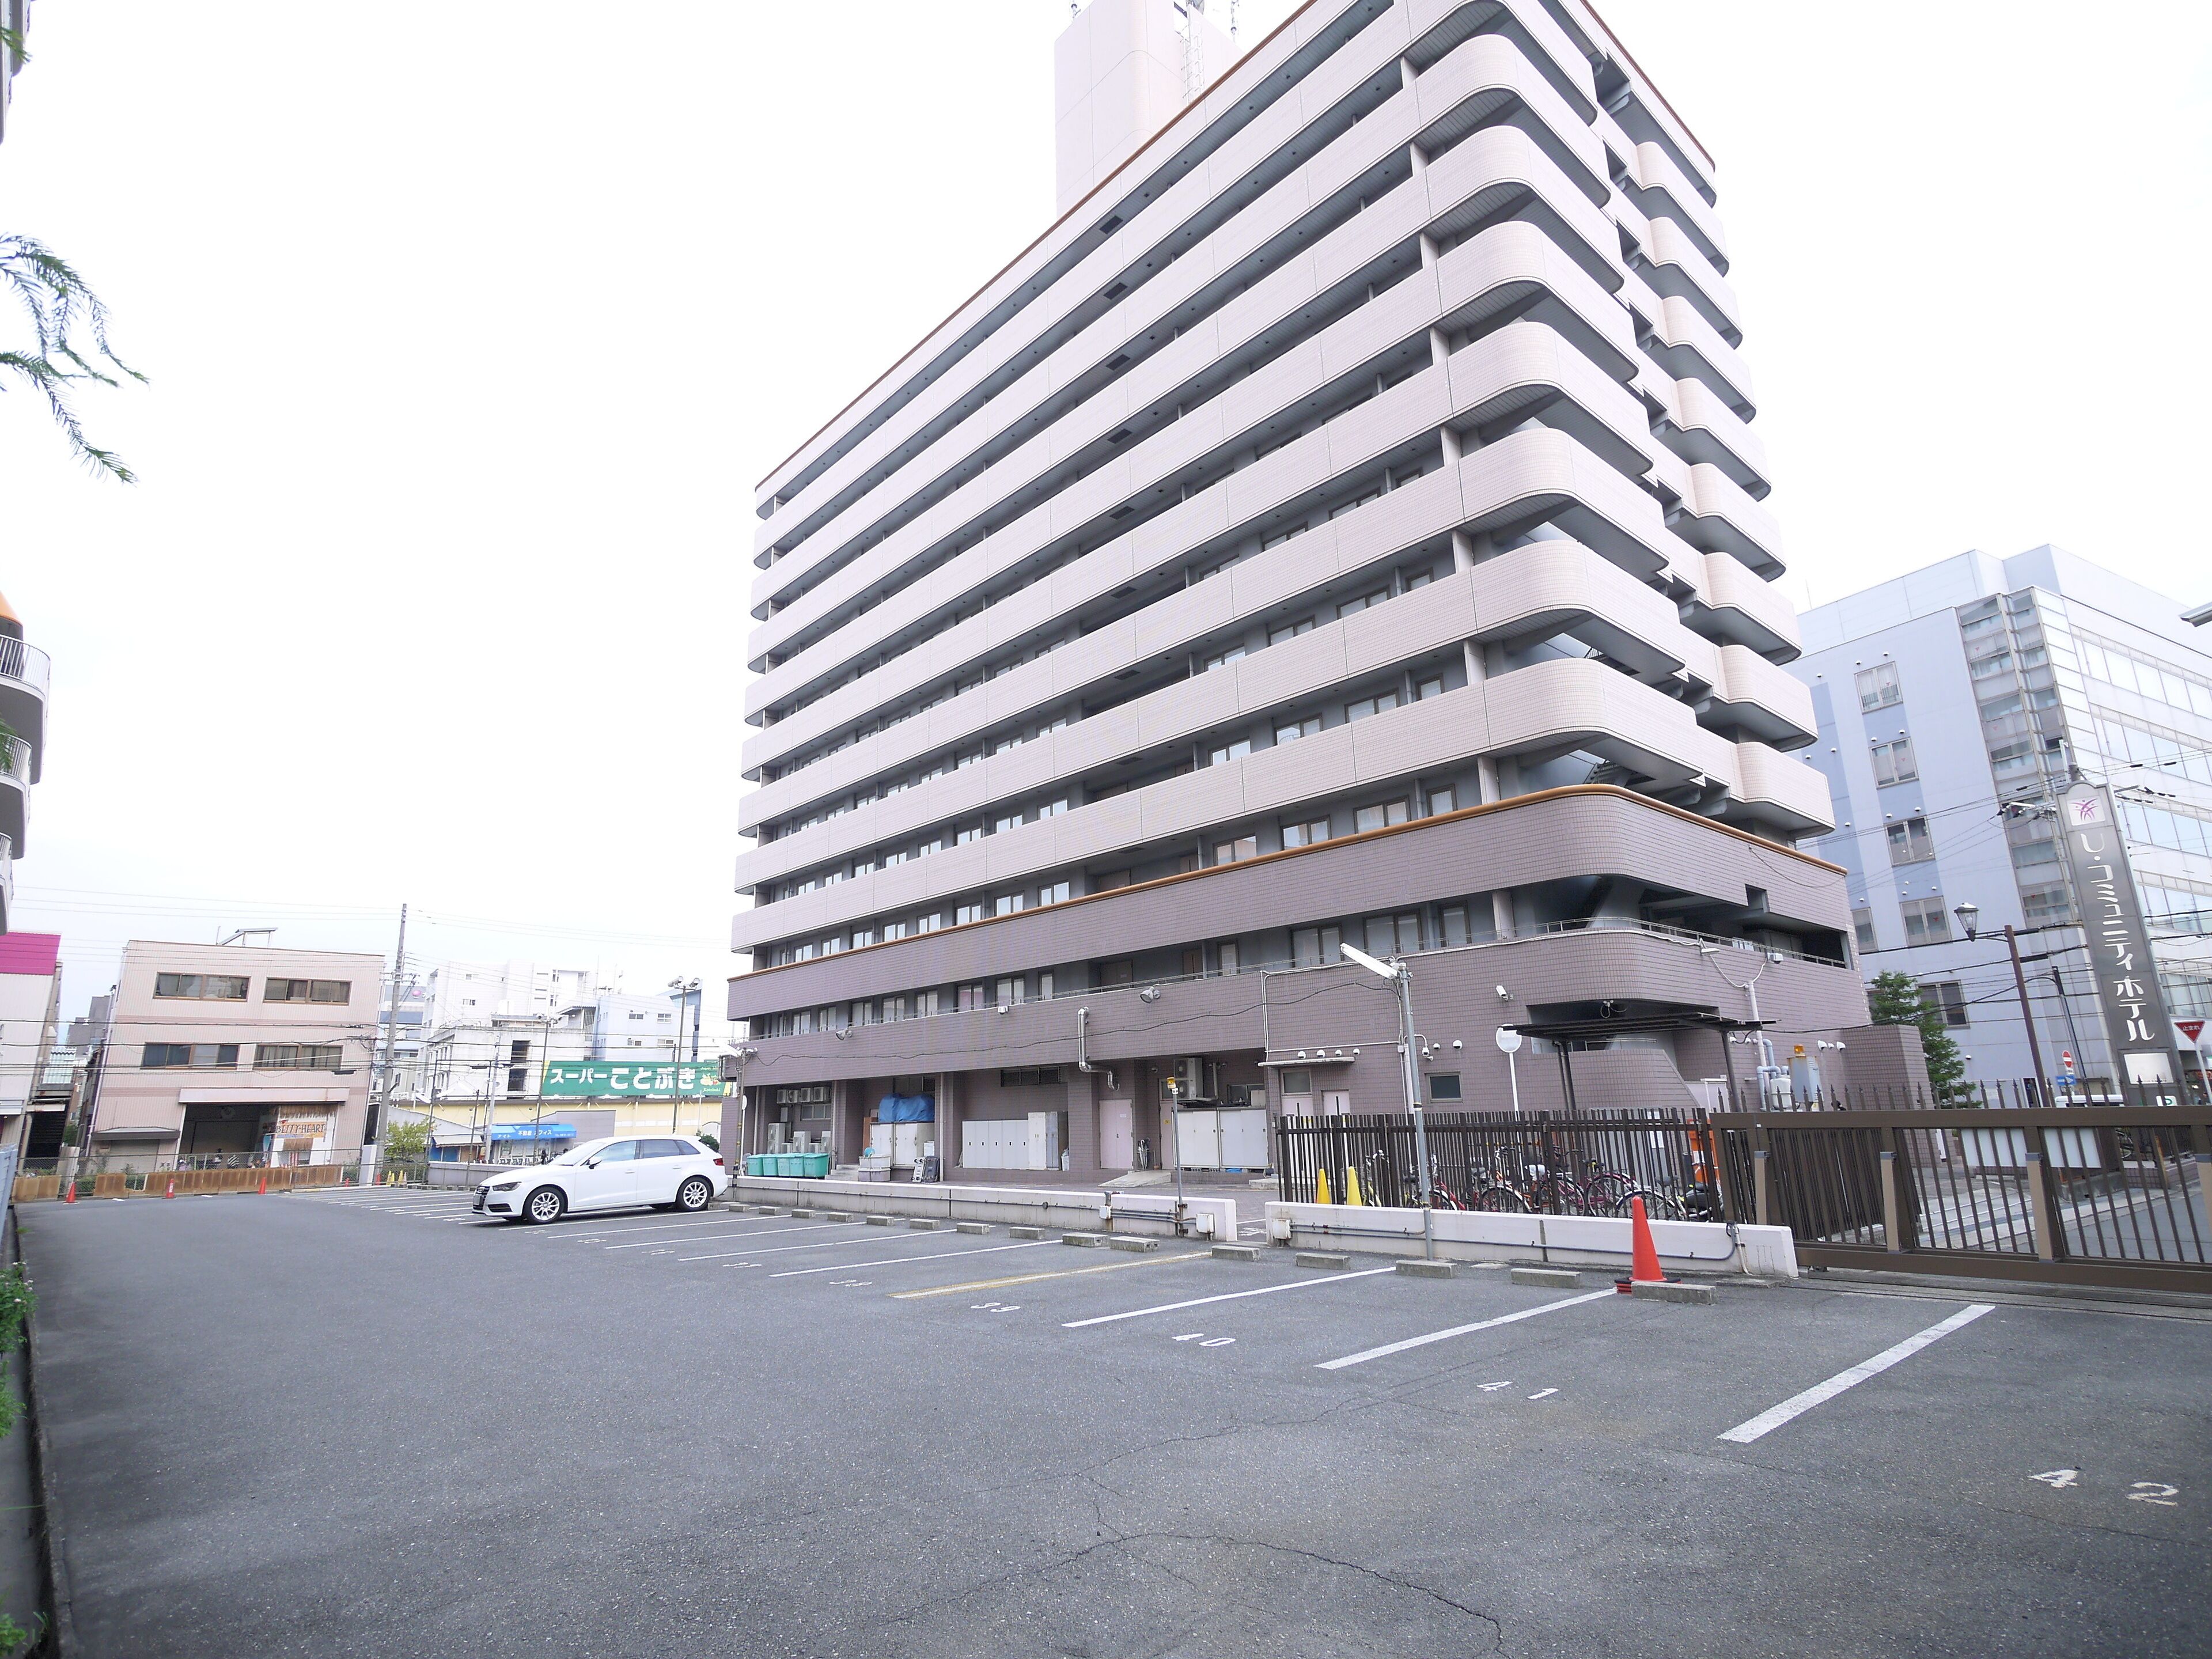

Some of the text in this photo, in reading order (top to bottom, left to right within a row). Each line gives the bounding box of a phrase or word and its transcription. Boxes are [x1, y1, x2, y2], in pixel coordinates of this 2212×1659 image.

[970, 1302, 1021, 1312] 39
[1171, 1332, 1236, 1347] 40
[1476, 1381, 1559, 1400] 41
[2027, 1469, 2180, 1507] 42
